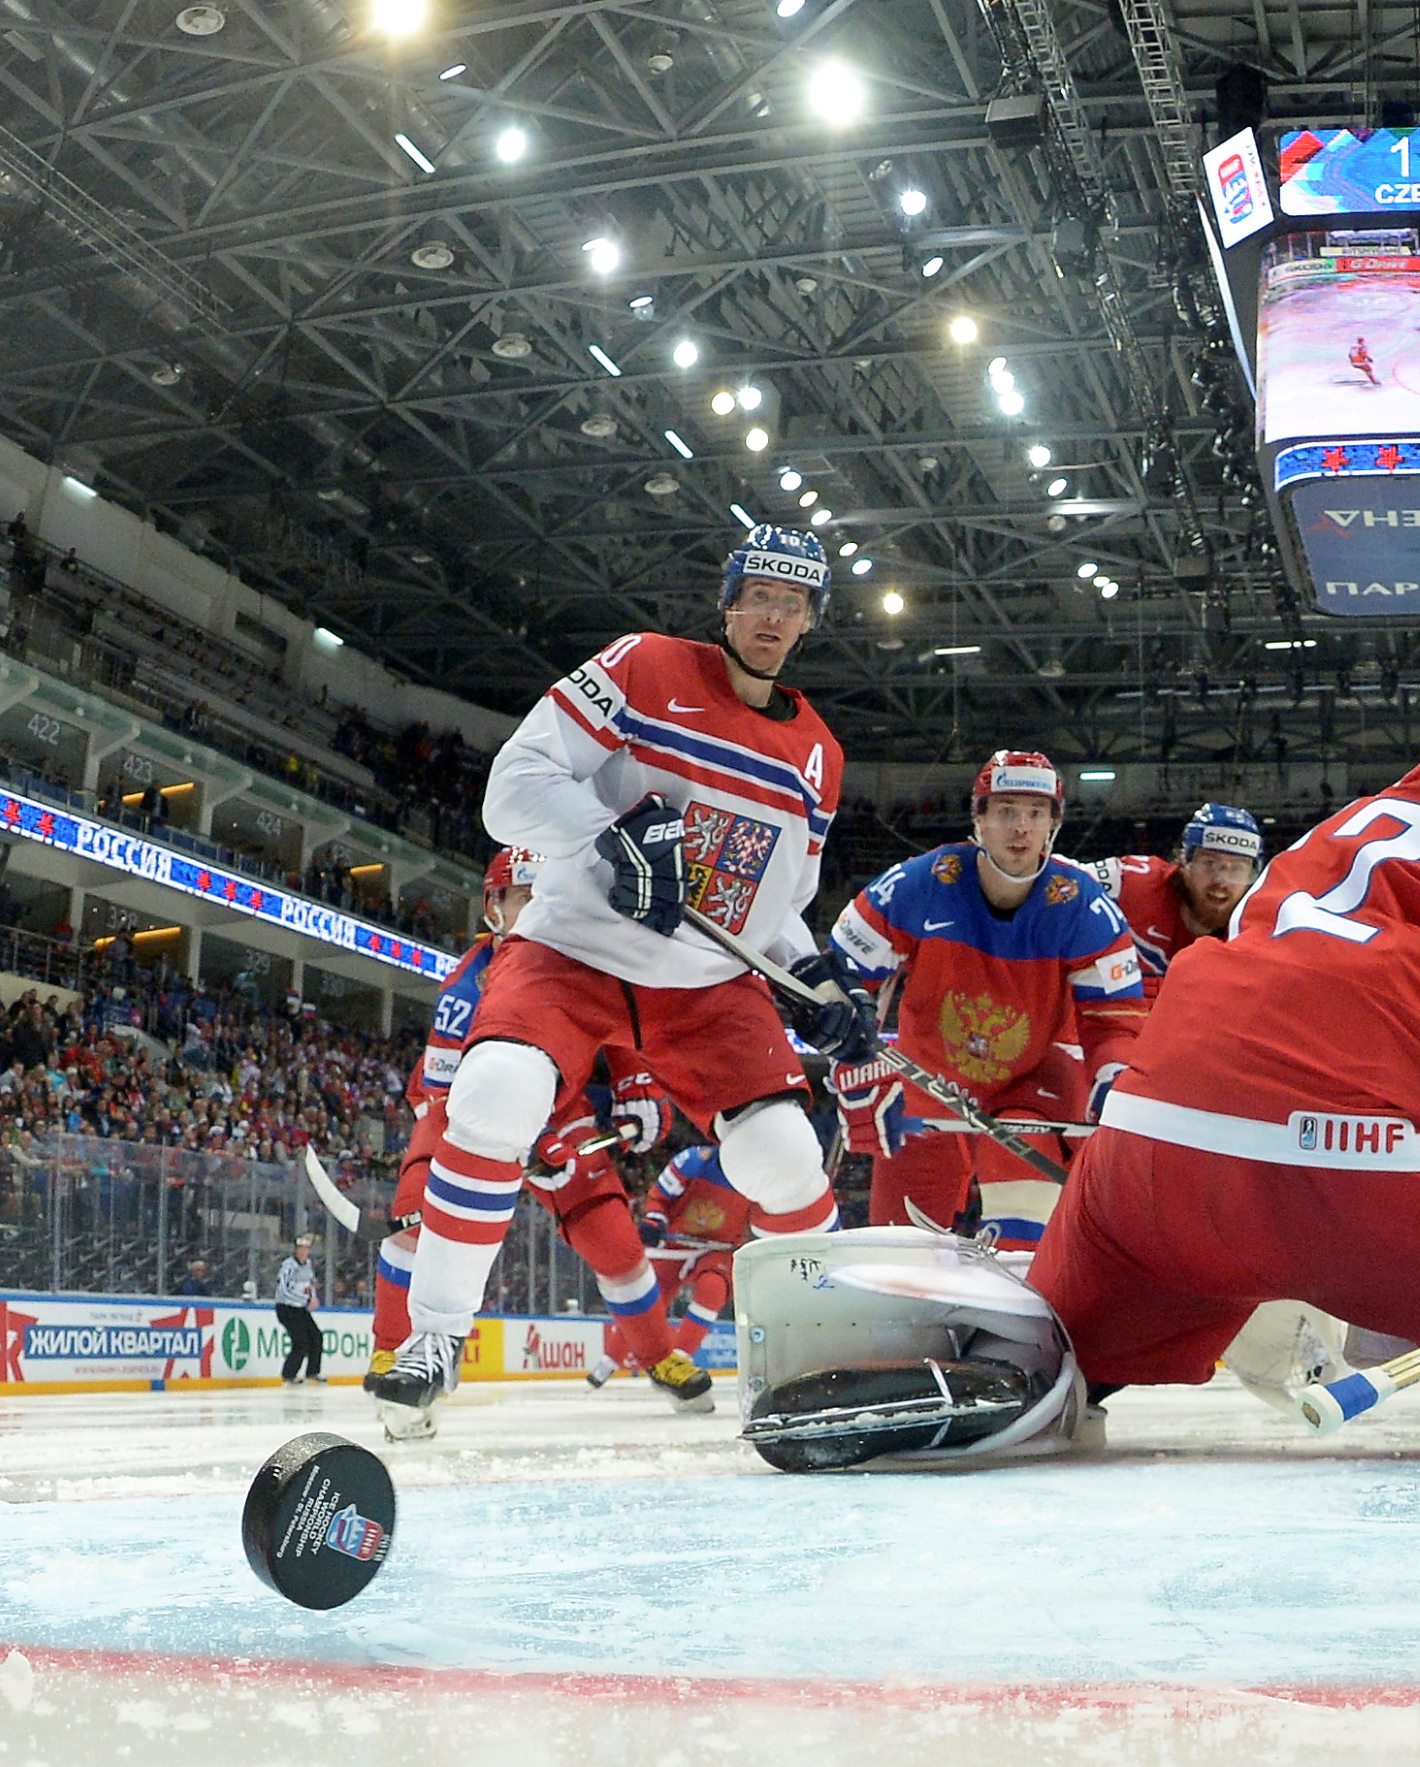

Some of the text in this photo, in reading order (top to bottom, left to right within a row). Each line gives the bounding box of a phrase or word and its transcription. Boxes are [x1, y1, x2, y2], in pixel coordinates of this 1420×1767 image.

[1391, 137, 1410, 178] 1
[27, 713, 61, 746] 422
[123, 753, 152, 783] 423
[805, 743, 824, 789] A
[76, 822, 173, 882] РОССИЯ
[281, 899, 358, 951] РОССИЯ
[433, 994, 472, 1037] 52
[1324, 1118, 1405, 1154] IIHF
[29, 1324, 199, 1355] ЖИЛОЙ КВАРТАЛ
[301, 1464, 321, 1499] Moscow
[295, 1496, 315, 1532] RUSSIA
[295, 1478, 331, 1558] CHAMPIONSHIP
[308, 1501, 330, 1541] WORLD
[310, 1491, 342, 1556] ICE HOCKEY
